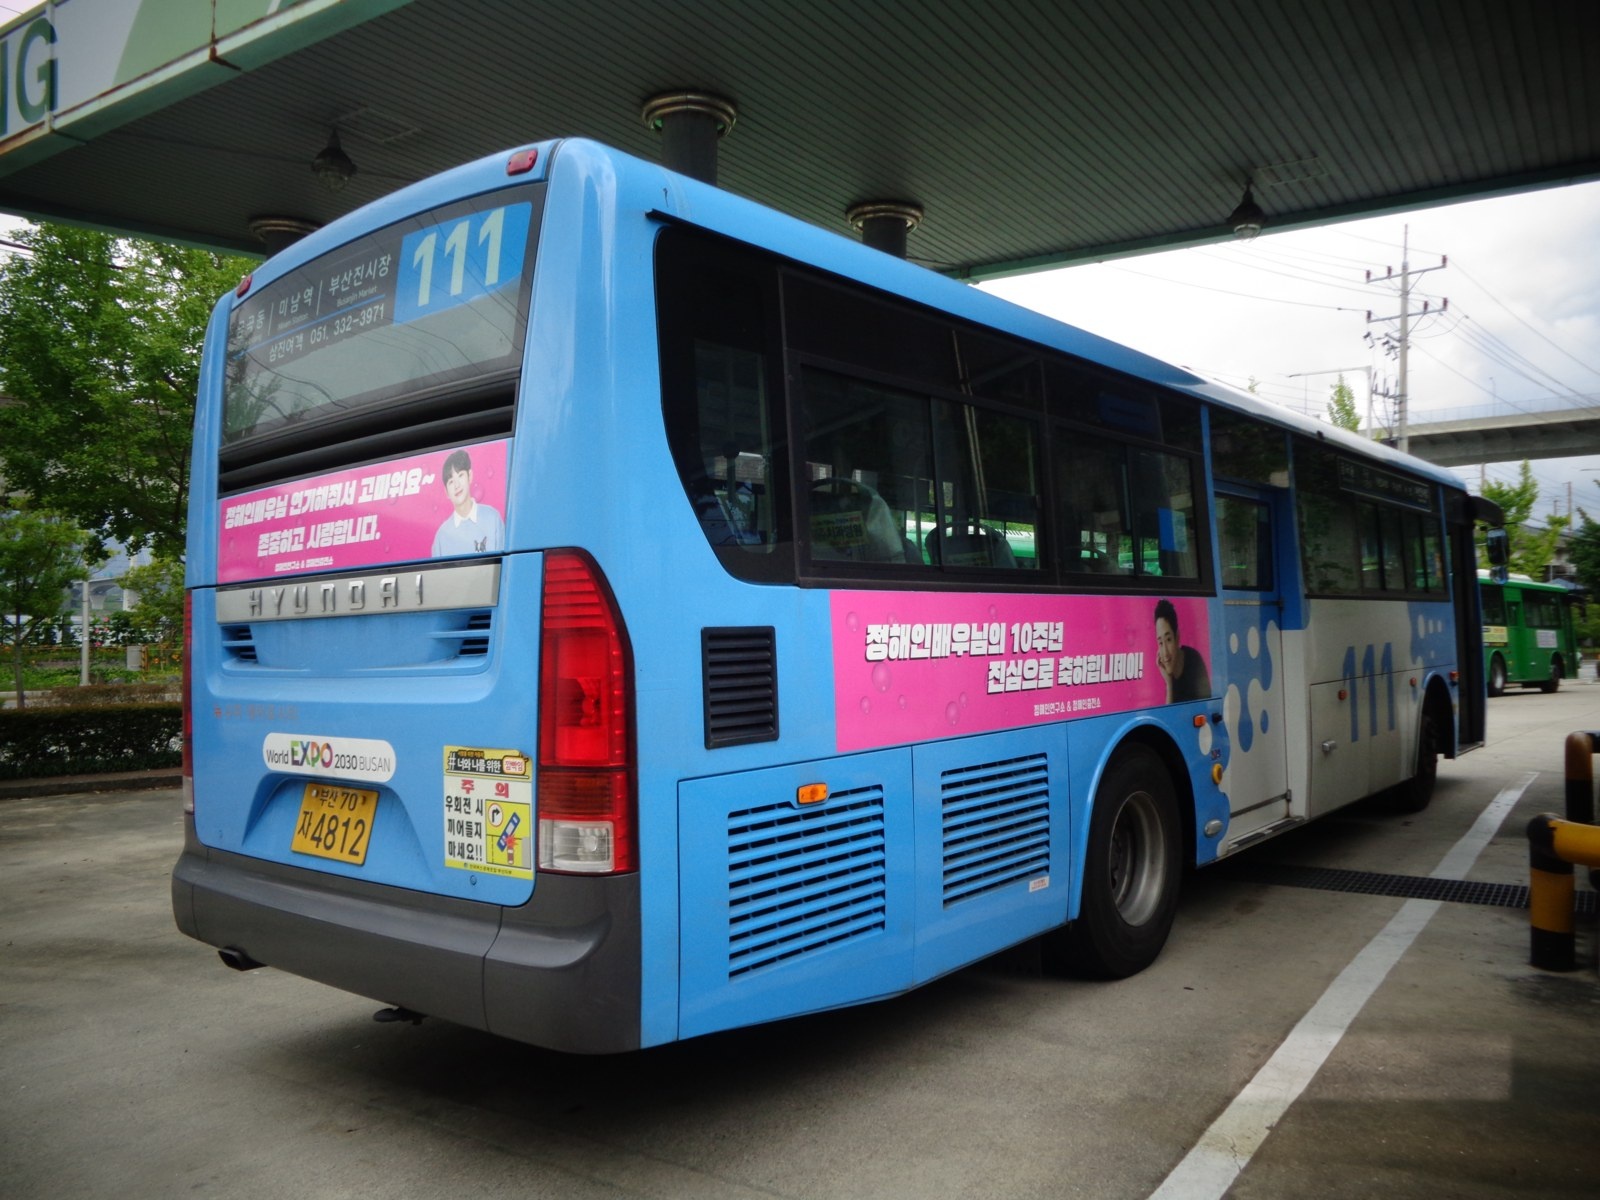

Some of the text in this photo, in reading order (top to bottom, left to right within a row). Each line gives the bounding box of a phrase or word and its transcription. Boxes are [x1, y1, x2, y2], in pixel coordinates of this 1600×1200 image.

[0, 17, 58, 136] G
[412, 206, 505, 307] 111
[279, 286, 314, 316] 미남역
[329, 254, 391, 296] 부산진시장
[269, 333, 304, 362] 삼진여객
[334, 303, 384, 336] 332-3971
[225, 495, 289, 529] 정해인배우님
[289, 480, 357, 516] 연기해줘서
[257, 514, 381, 557] 존중하고 사랑합니다.
[250, 574, 423, 616] HYUNDAI
[865, 621, 1064, 661] 정해인배우님의 10주년
[987, 652, 1144, 694] 진심으로 축하합니데이!
[1343, 642, 1395, 743] 111
[266, 740, 391, 772] World EXPO 2030 BUSAN
[486, 760, 501, 773] 위한
[446, 796, 483, 816] 우회전 시
[448, 819, 482, 839] 끼어들지
[448, 841, 482, 861] 마세요!!
